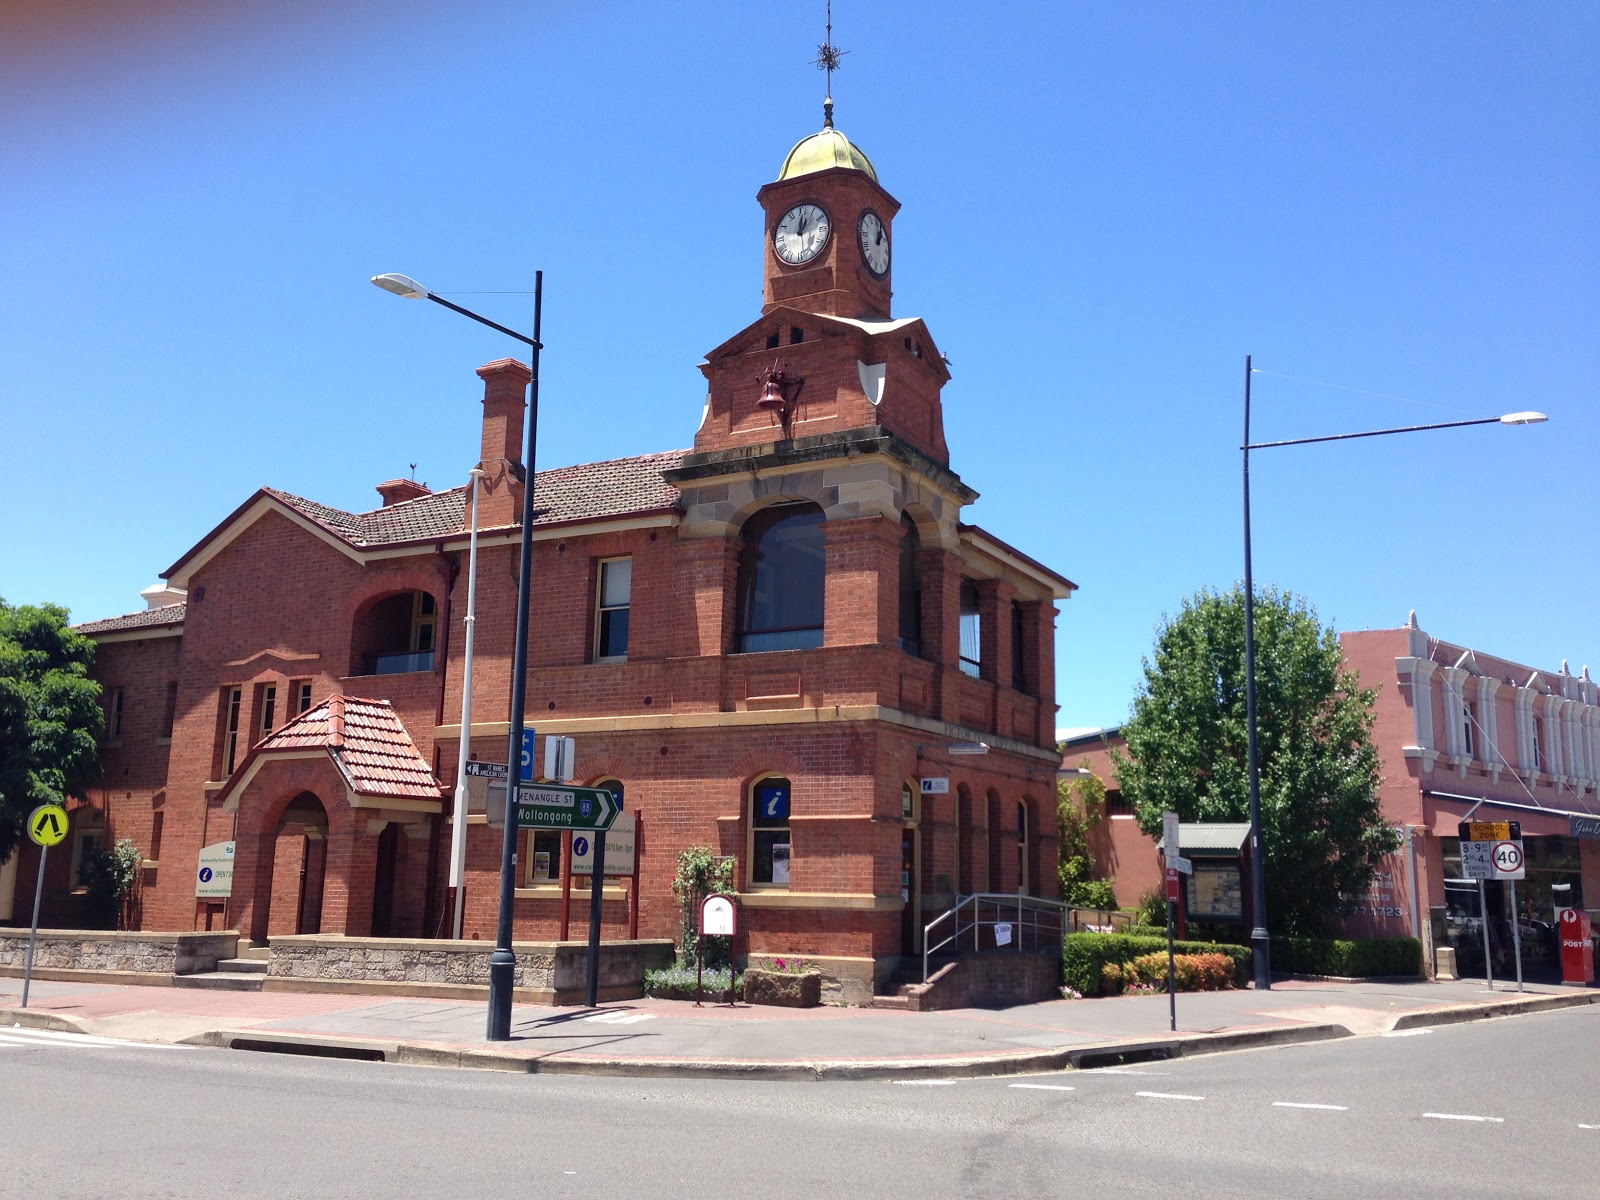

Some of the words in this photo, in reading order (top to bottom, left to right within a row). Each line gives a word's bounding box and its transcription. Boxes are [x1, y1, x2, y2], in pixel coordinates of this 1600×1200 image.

[497, 771, 508, 779] CHU
[563, 795, 573, 804] ST
[581, 802, 590, 812] 88
[517, 808, 572, 825] Wollongong
[1479, 831, 1501, 839] ZONE
[1497, 850, 1518, 864] 40
[215, 870, 226, 878] OPEN
[1371, 907, 1403, 917] 1723
